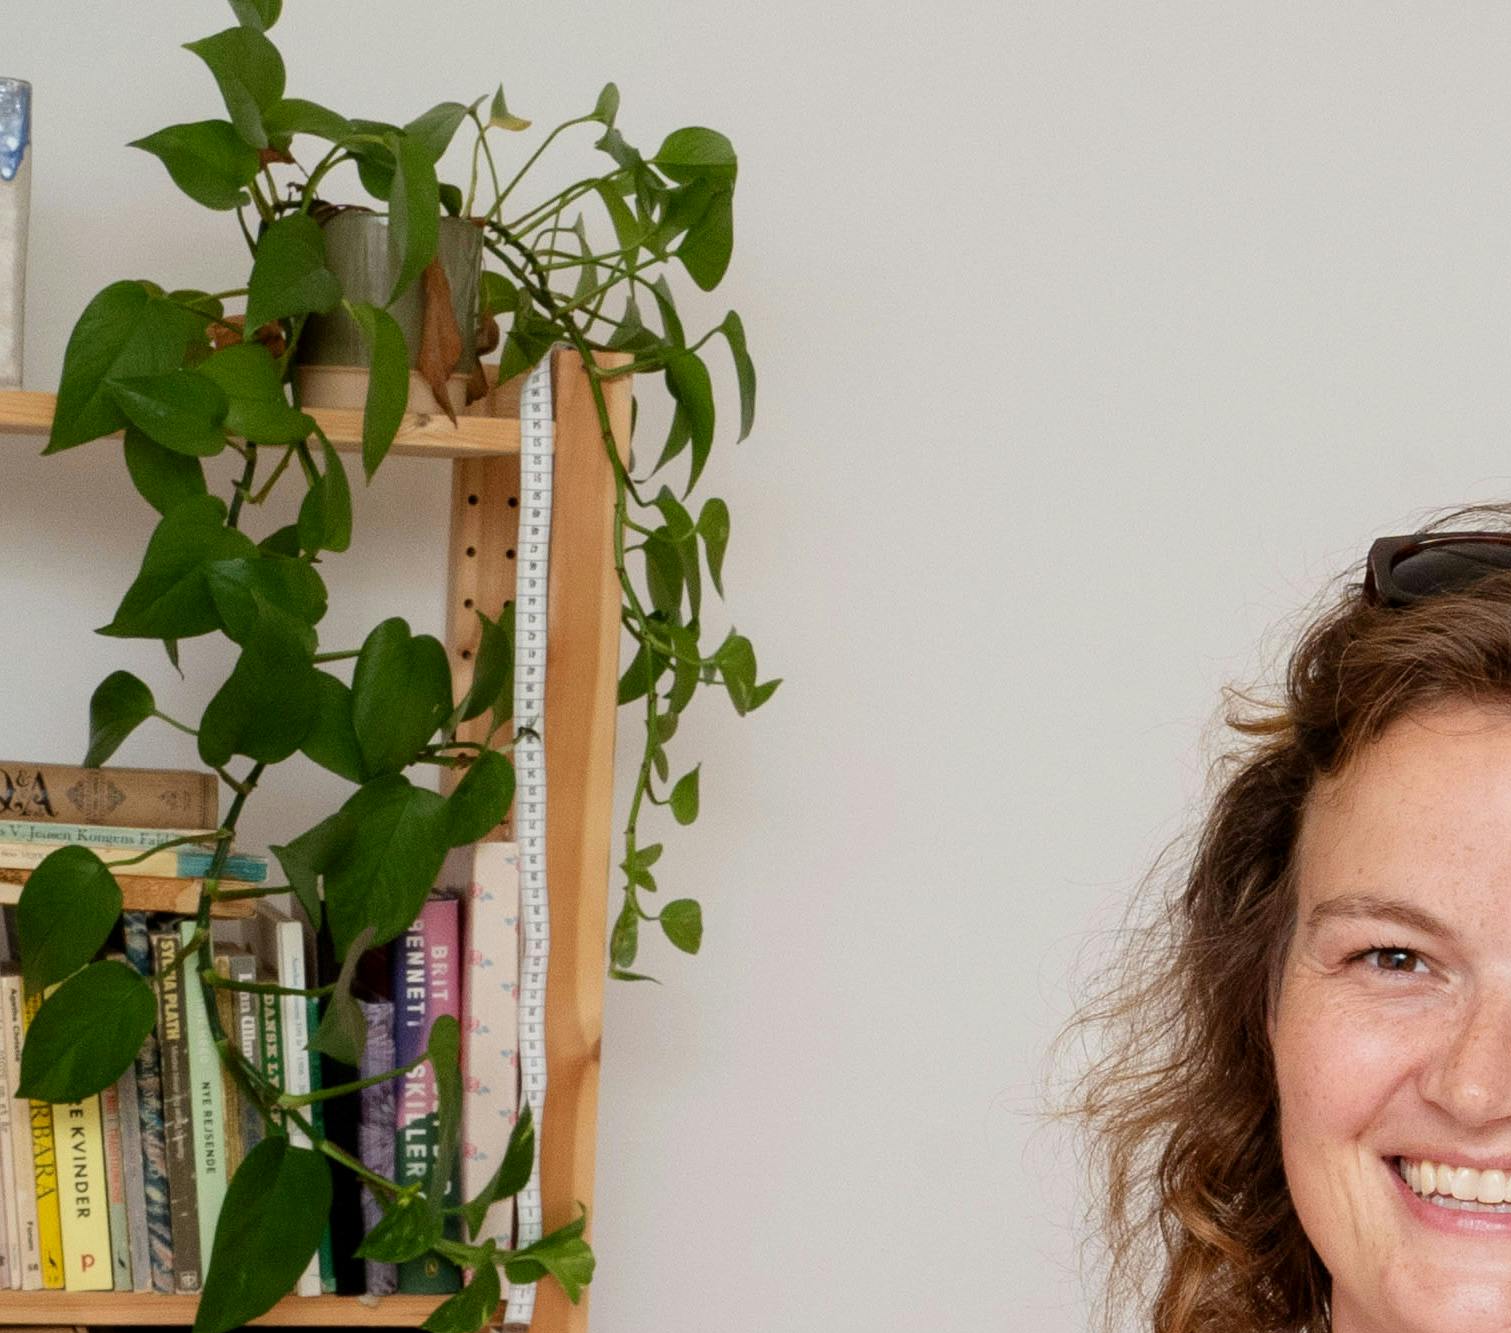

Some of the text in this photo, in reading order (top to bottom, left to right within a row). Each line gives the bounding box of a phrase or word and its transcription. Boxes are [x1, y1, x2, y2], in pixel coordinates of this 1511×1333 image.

[78, 828, 134, 845] Kongens
[161, 941, 177, 993] SYLIA
[239, 973, 254, 1013] Lnn
[431, 944, 449, 1000] BRIT
[163, 995, 181, 1040] PLATH
[263, 994, 279, 1058] DANSK
[201, 1082, 217, 1175] NYE REJSENDE
[69, 1127, 91, 1219] KVINDER
